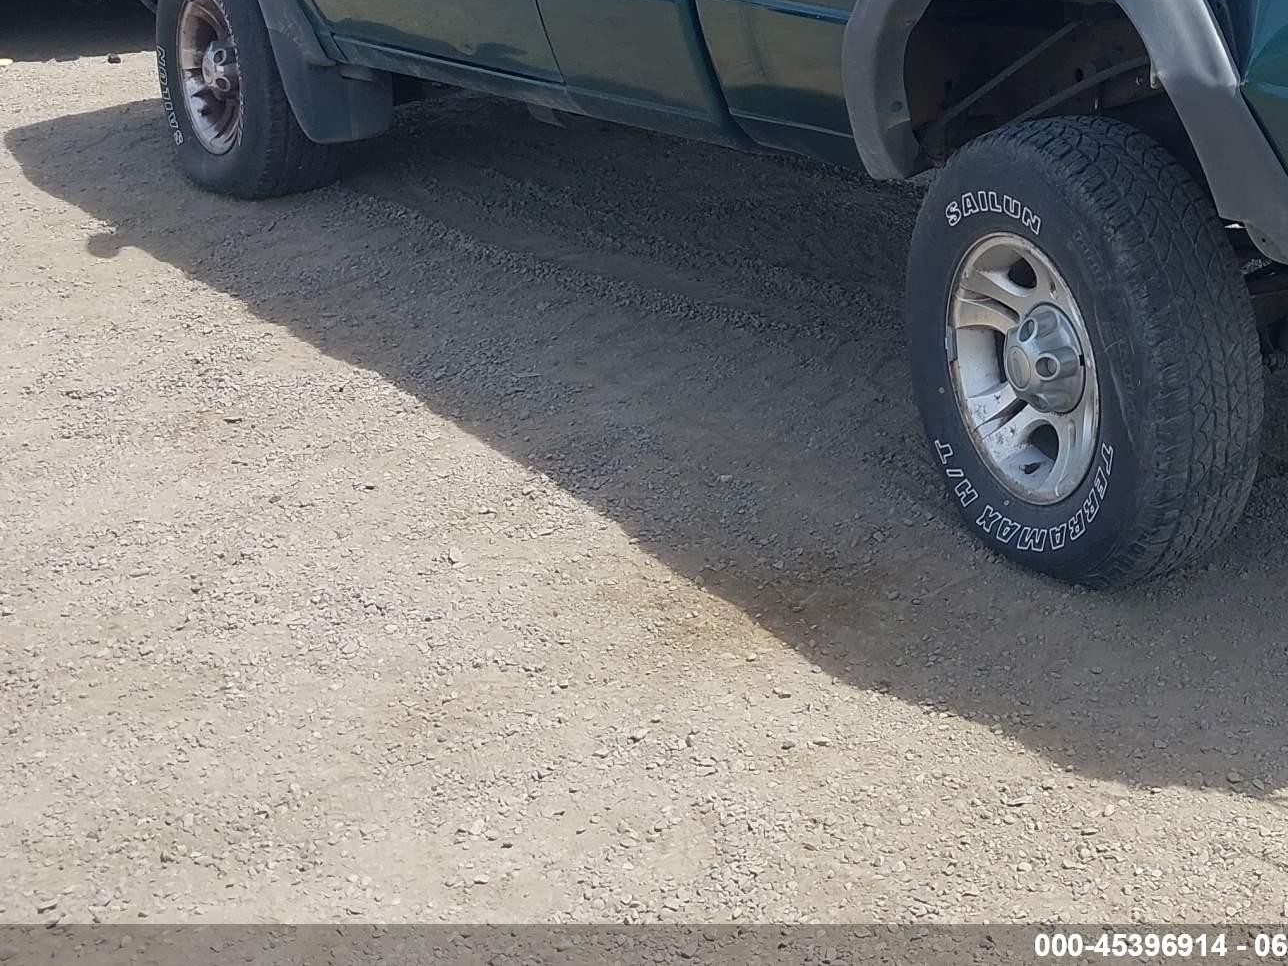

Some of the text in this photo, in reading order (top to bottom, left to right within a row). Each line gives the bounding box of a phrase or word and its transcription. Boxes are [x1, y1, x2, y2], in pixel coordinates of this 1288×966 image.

[156, 45, 184, 146] SAILUN
[945, 191, 1041, 235] SAILUN
[976, 442, 1114, 552] TERRAMAX
